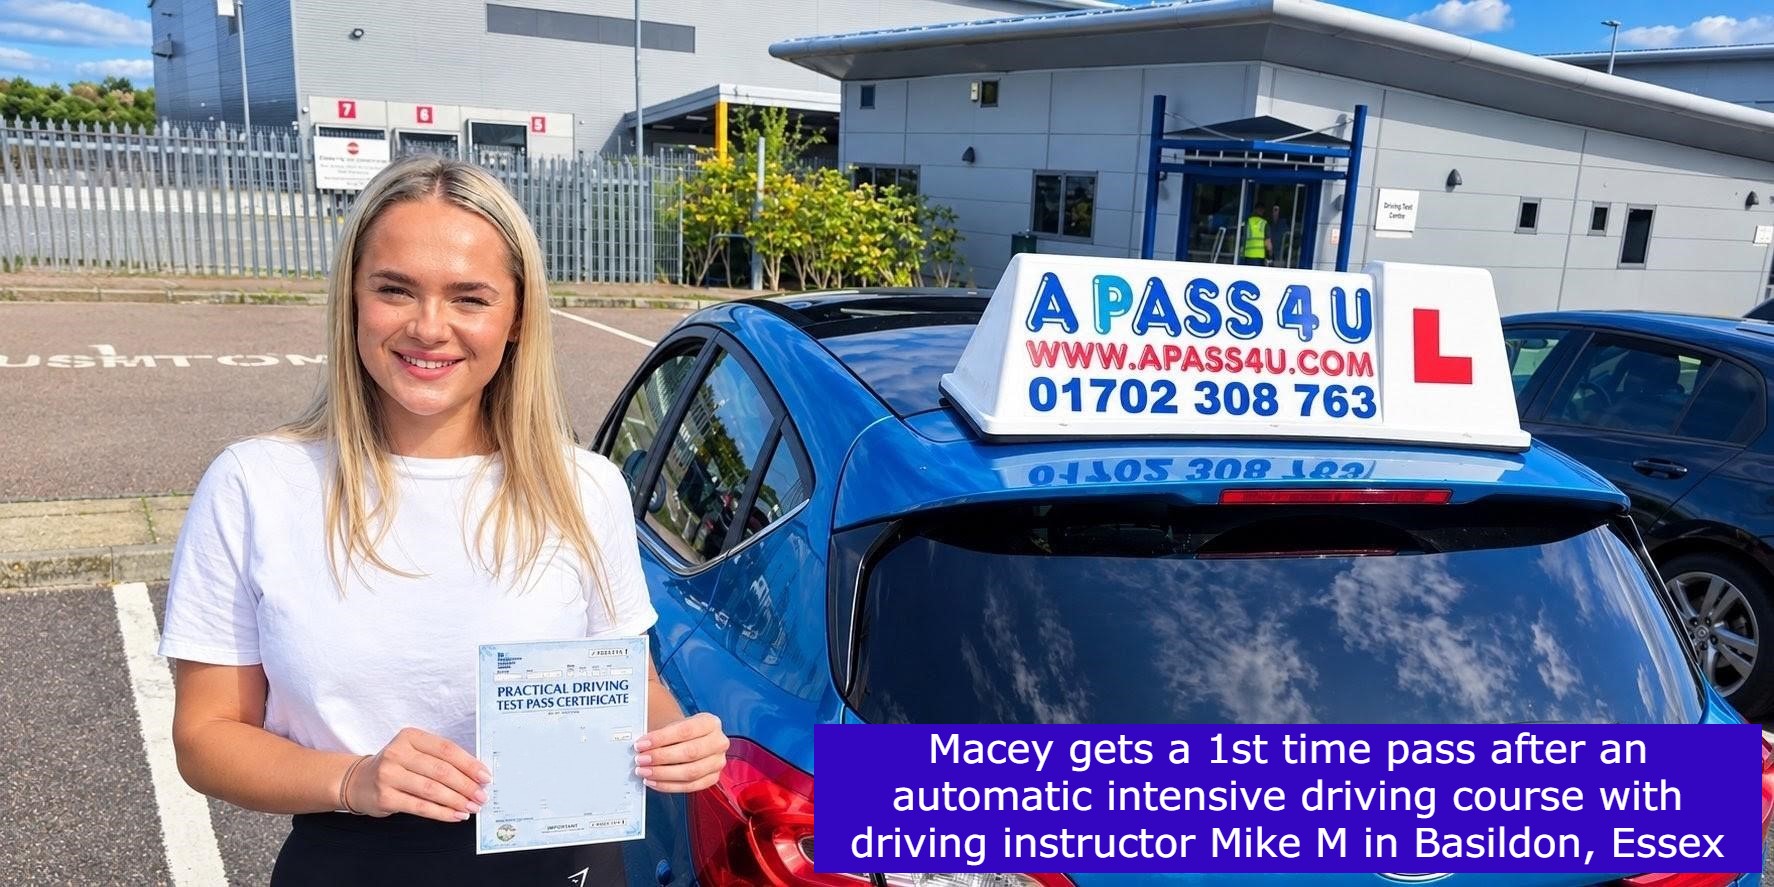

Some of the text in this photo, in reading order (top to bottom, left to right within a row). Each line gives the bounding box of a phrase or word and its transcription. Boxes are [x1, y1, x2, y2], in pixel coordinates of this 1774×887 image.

[342, 104, 352, 116] 7
[420, 110, 428, 121] 6
[534, 118, 543, 130] 5
[1384, 202, 1401, 211] Driving
[1025, 271, 1374, 344] A PASS 4 U
[1413, 308, 1474, 385] L
[1025, 340, 1375, 378] WWW.APASS4U.COM
[1028, 376, 1377, 420] 01702 308 763
[498, 680, 629, 697] PRACTICAL DRIVING
[497, 693, 629, 711] TEST PASS CERTIFICATE
[547, 823, 578, 831] IMPORTANT
